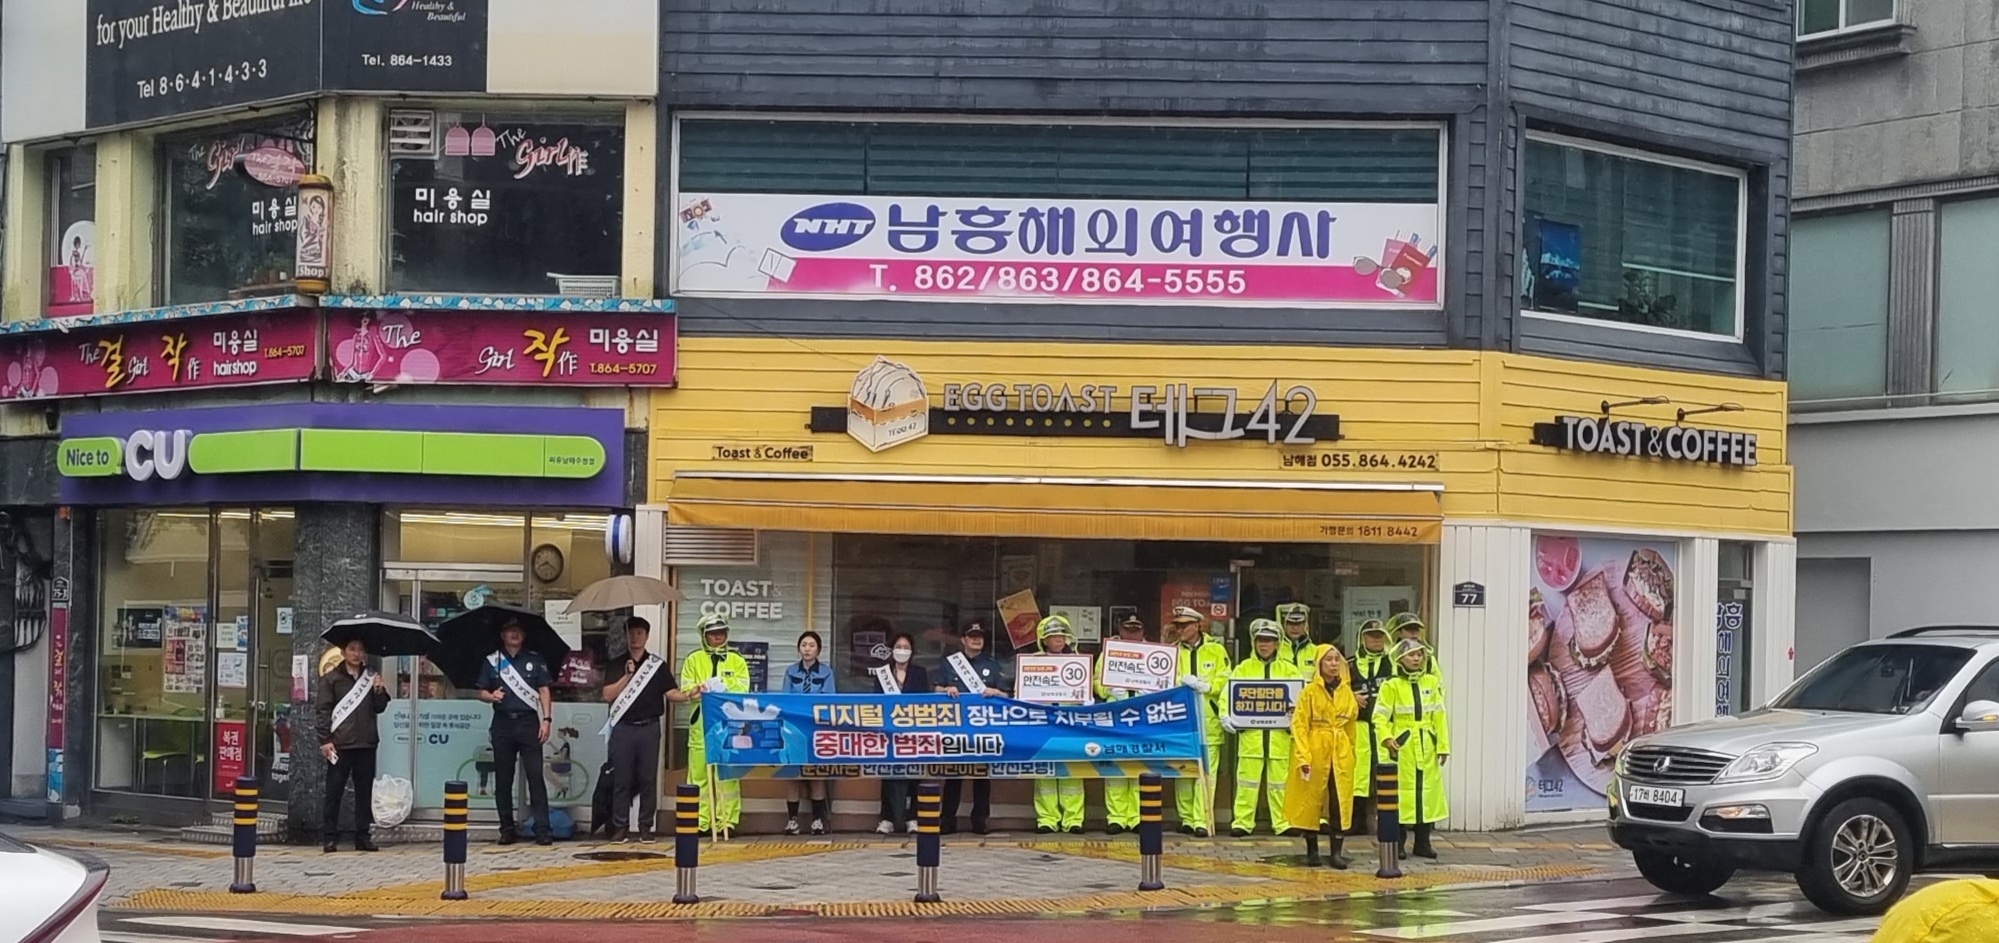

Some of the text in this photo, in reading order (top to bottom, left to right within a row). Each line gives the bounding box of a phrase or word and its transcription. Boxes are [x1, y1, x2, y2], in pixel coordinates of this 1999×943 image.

[96, 14, 116, 45] for
[118, 17, 150, 49] your
[152, 0, 204, 33] Healthy
[206, 2, 219, 22] &
[427, 11, 467, 23] Beautiful
[362, 54, 453, 67] Tel. 864-1433
[137, 80, 155, 99] Tel
[495, 128, 527, 149] The
[252, 196, 297, 219] 미용실
[415, 187, 490, 210] 미용실
[252, 218, 298, 236] hair shop
[413, 209, 488, 226] hair shop
[793, 218, 875, 235] NHT
[888, 203, 1337, 259] 남흥해외여행사
[870, 264, 1247, 294] T. 862/863/864-5555
[213, 329, 258, 355] 미용실
[382, 324, 422, 348] The
[589, 328, 659, 354] 미용실
[79, 343, 100, 364] The
[99, 334, 126, 388] 걸
[160, 332, 188, 382] 작
[474, 327, 569, 378] Girl 작
[589, 361, 657, 376] T.864-5707
[943, 382, 1118, 414] EGG TOAST
[66, 448, 109, 466] Nice to
[125, 429, 189, 481] CU
[716, 446, 809, 460] Toast & Coffee
[1283, 453, 1436, 468] 남해점 055.864.4242
[1461, 593, 1478, 604] 77
[700, 600, 783, 619] COFFEE
[1109, 656, 1170, 675] 안전속도 30
[1023, 674, 1060, 687] 안전속도
[1065, 667, 1083, 681] 30
[813, 703, 884, 727] 디지털
[890, 702, 962, 727] 성범죄
[966, 705, 1048, 727] 장난으로
[1120, 708, 1140, 727] 수
[1146, 700, 1188, 724] 없는
[223, 730, 239, 745] 복권
[428, 734, 449, 744] CU
[815, 731, 1003, 757] 중대한 범죄입니다
[219, 746, 242, 761] 판매점
[1103, 742, 1167, 755] 남해경찰서
[1652, 789, 1678, 804] 8404
